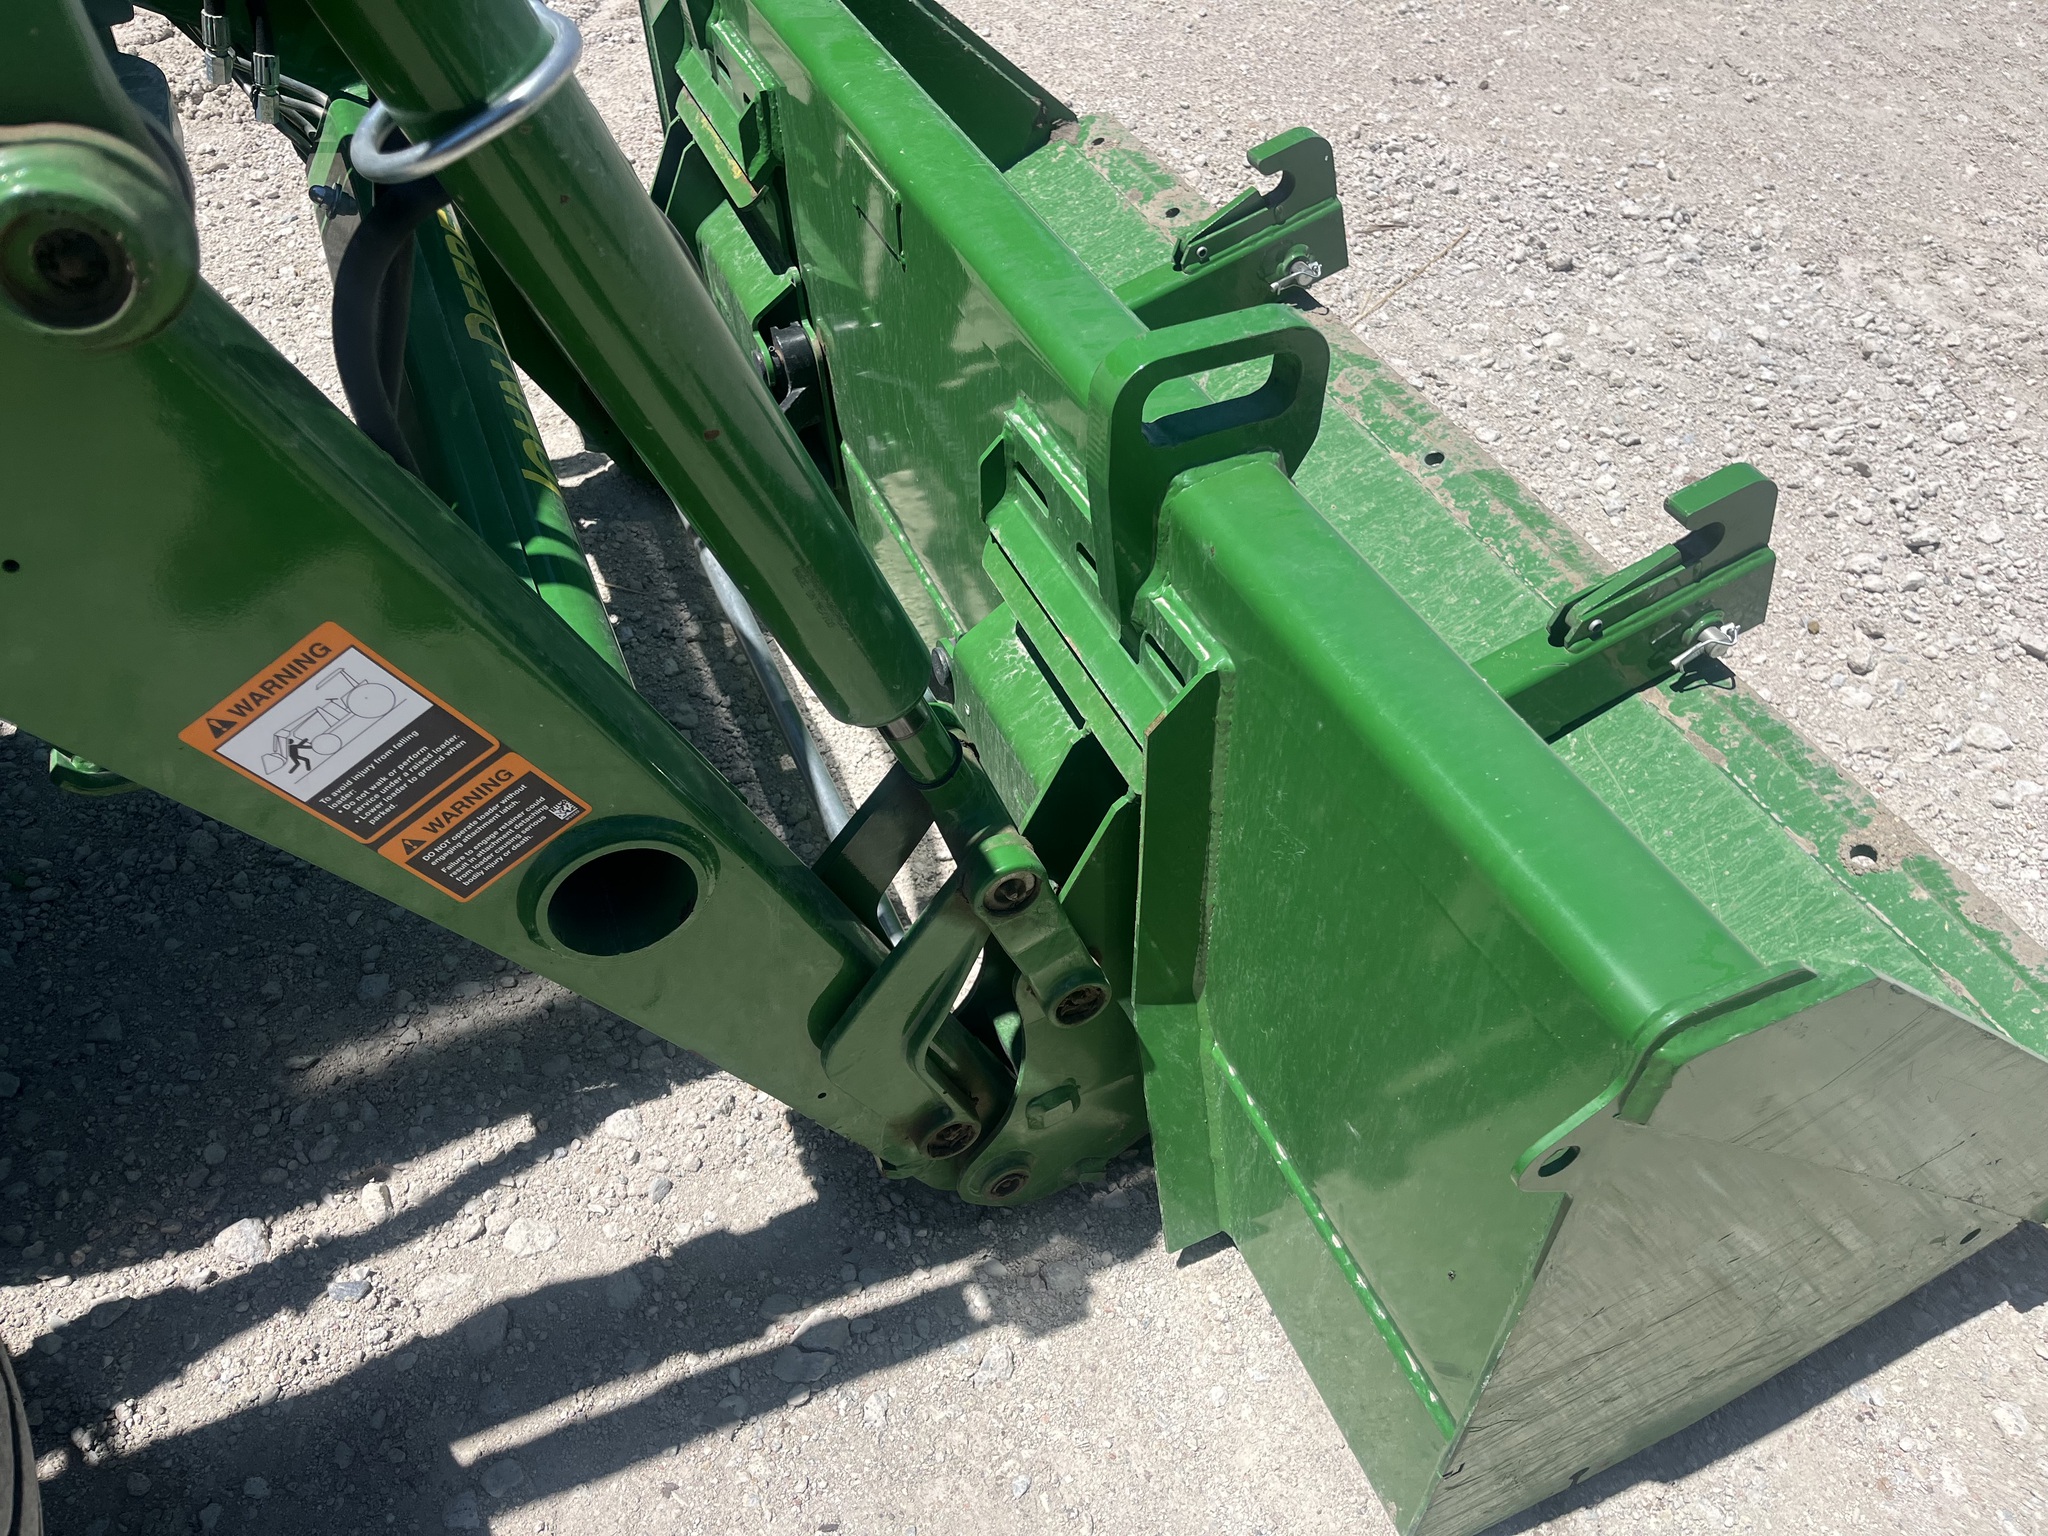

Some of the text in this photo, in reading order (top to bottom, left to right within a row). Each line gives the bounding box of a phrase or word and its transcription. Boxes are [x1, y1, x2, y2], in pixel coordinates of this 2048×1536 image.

[226, 642, 333, 718] WARNING
[318, 730, 420, 804] To avoid injury from falling
[341, 745, 429, 811] Do not walk or perform
[352, 793, 381, 815] service
[379, 776, 403, 795] under
[408, 752, 434, 773] raised
[431, 734, 460, 755] loader.
[358, 740, 467, 820] Lower loader to ground when
[421, 769, 515, 834] WARNING
[368, 803, 399, 826] parked.
[421, 784, 528, 862] DO NOT operate loader without
[430, 800, 521, 866] engaging attachment latch.
[440, 795, 546, 874] Failure to engage retainer could
[449, 861, 470, 878] result
[467, 856, 478, 864] in
[476, 828, 515, 858] attachment
[513, 804, 550, 830] detaching
[455, 868, 474, 882] from
[471, 852, 495, 870] loader
[494, 833, 523, 854] causing
[520, 815, 547, 835] serious
[461, 835, 534, 887] bodily injury or death.
